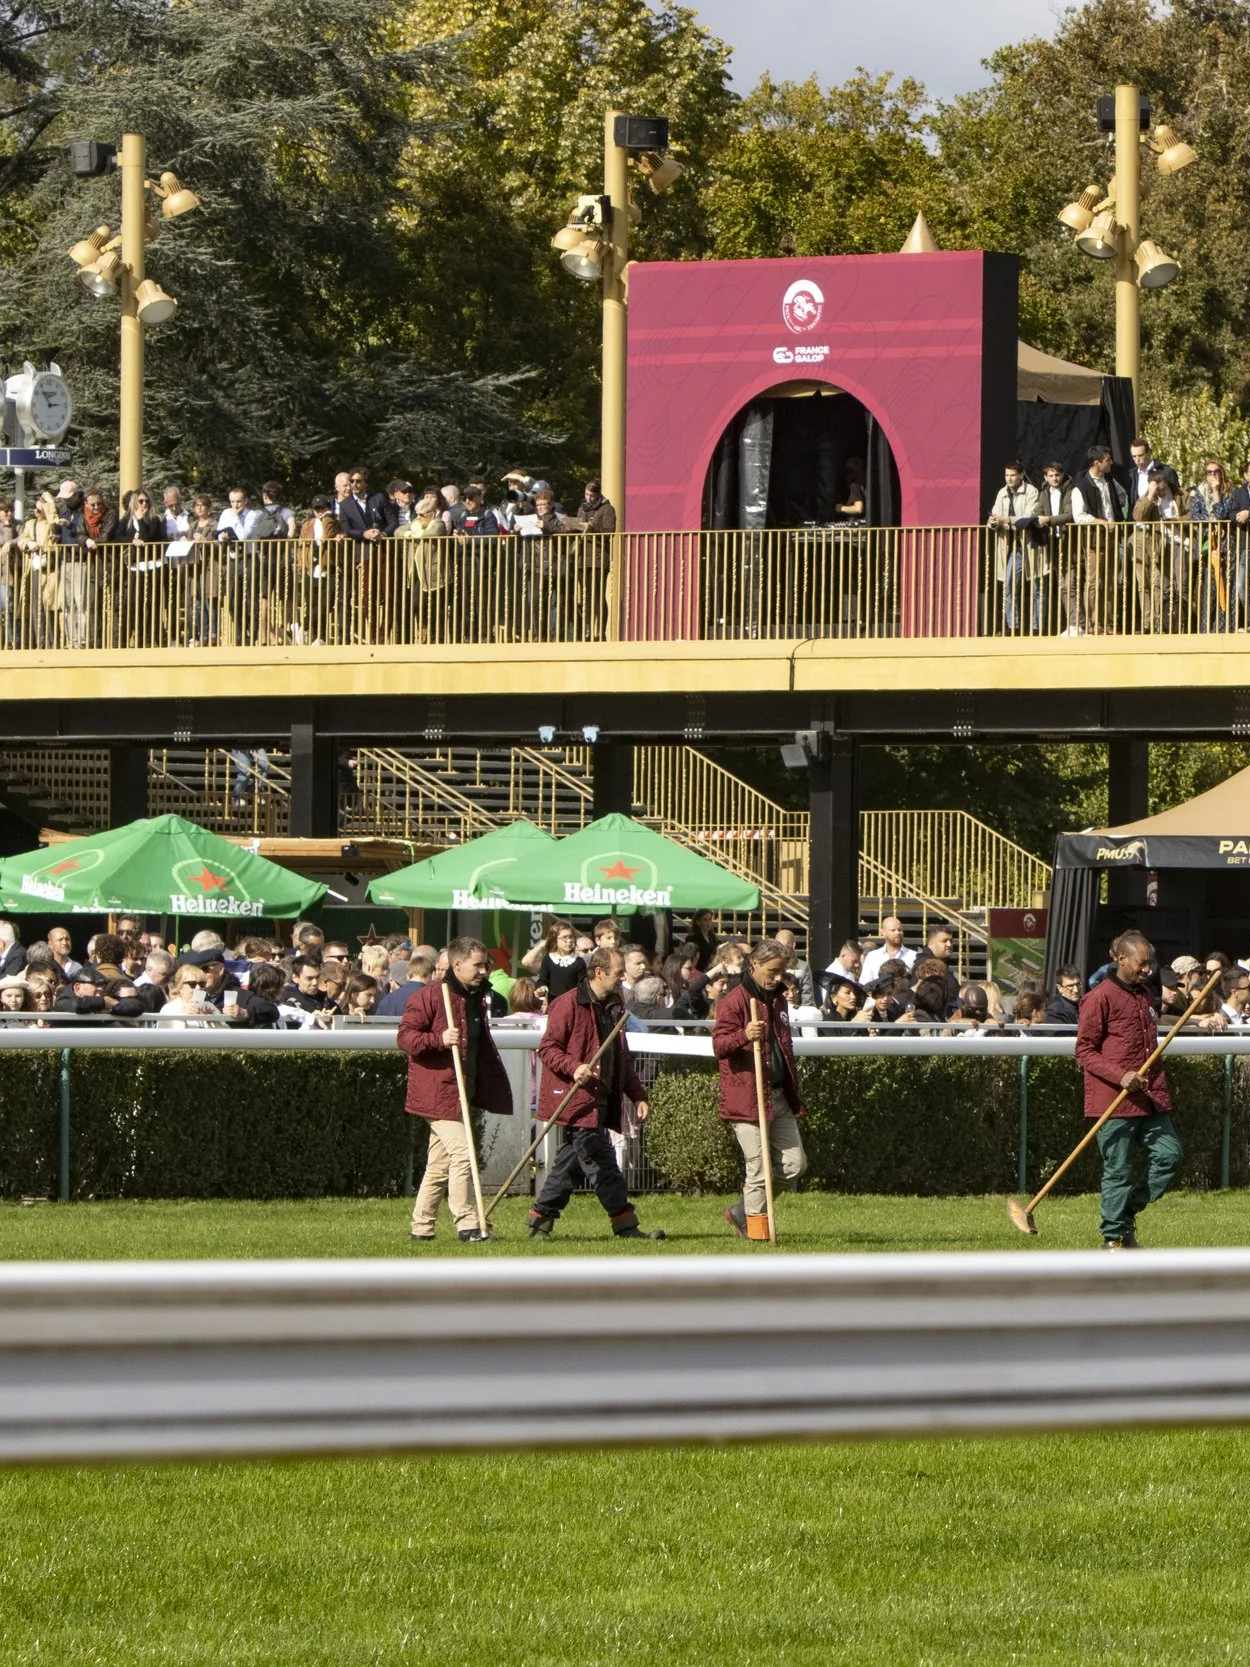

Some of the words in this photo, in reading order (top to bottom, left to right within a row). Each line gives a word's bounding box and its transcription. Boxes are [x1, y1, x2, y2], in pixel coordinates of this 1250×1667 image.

[795, 346, 829, 354] FRANCE
[794, 355, 824, 363] GALOP
[1096, 848, 1126, 860] PMU
[563, 882, 671, 906] Heineken
[170, 895, 263, 917] Heineken
